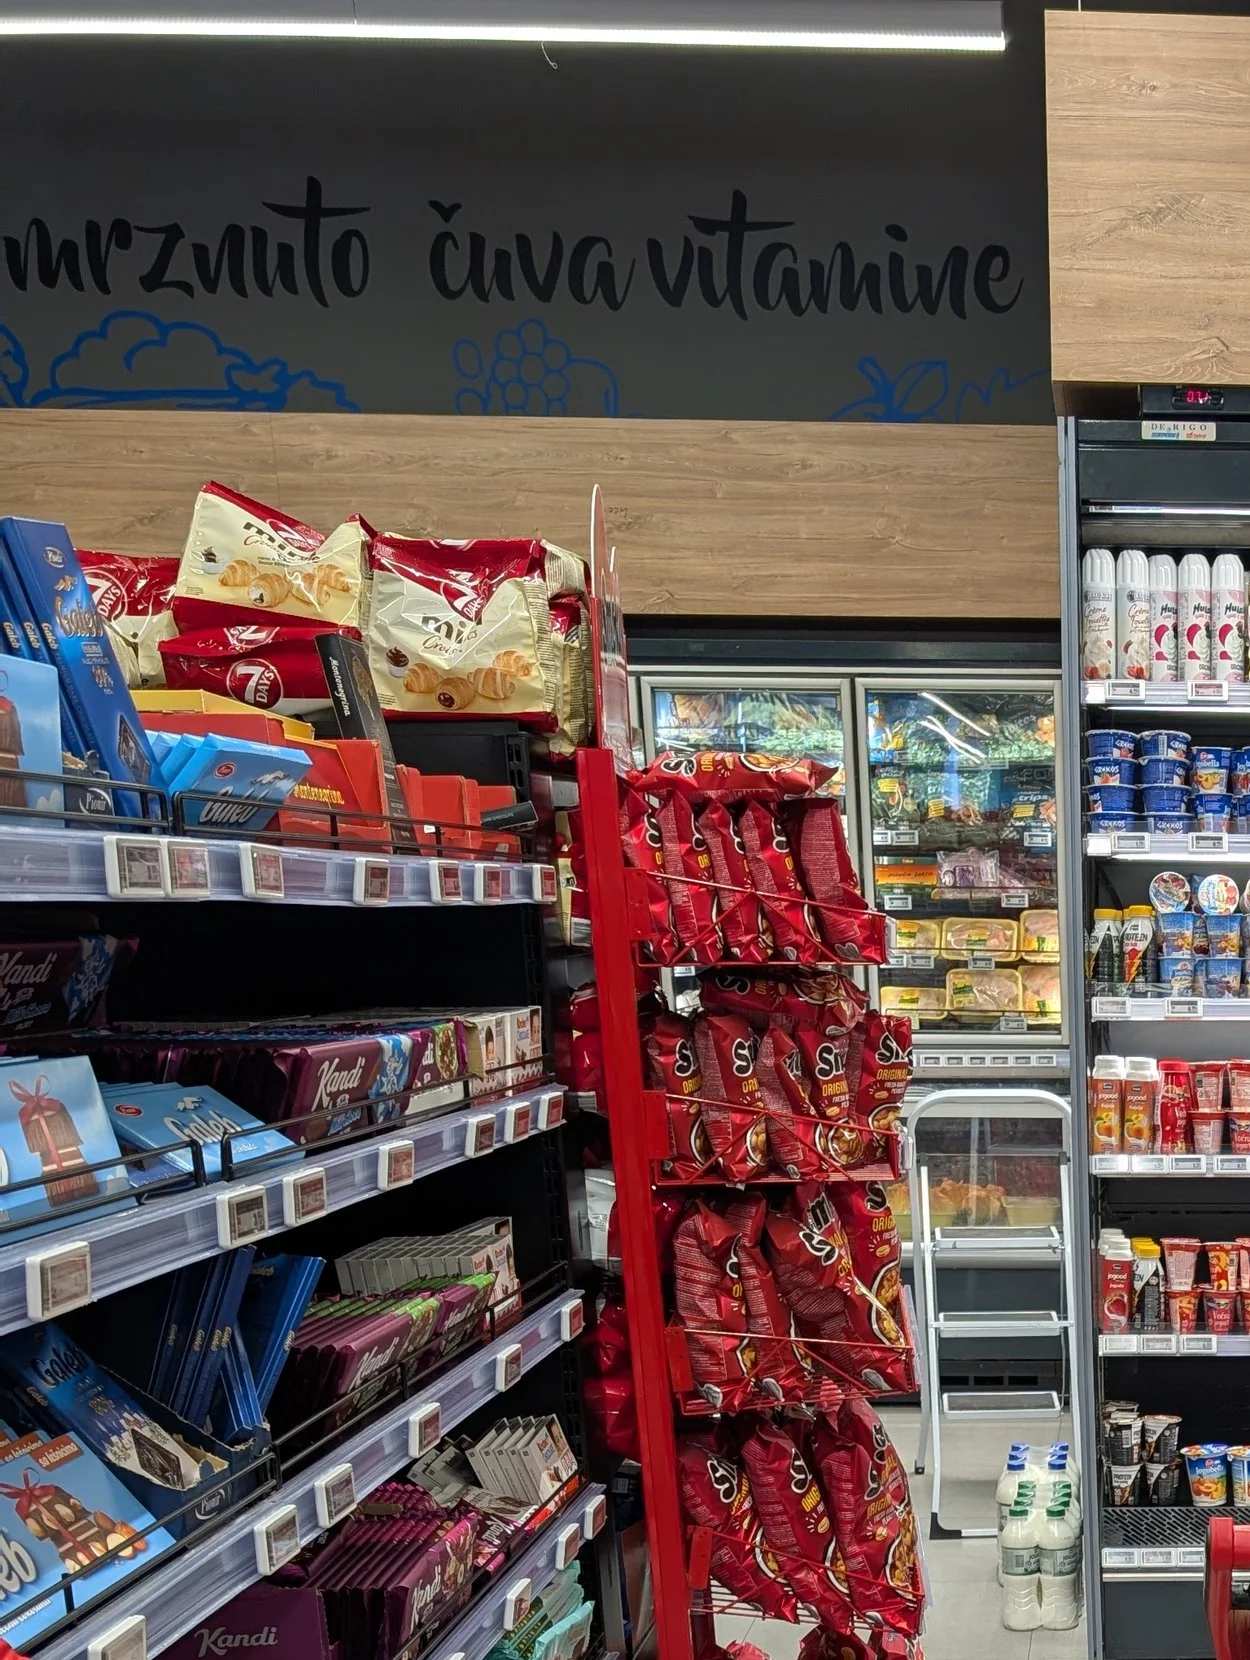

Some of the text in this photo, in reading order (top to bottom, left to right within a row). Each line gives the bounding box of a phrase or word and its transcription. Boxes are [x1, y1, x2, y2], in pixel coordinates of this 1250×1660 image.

[3, 176, 1025, 320] mrznuto čuva vitamine
[3, 621, 21, 650] Galeb
[23, 620, 40, 649] Galeb
[41, 622, 58, 650] Galeb
[54, 596, 104, 638] Galeb
[236, 664, 263, 709] 7
[256, 669, 276, 704] DAYS
[329, 655, 351, 717] Montenegrina
[311, 1056, 366, 1112] Kandi
[31, 1342, 88, 1389] Galeb
[356, 1337, 401, 1389] Kandi
[47, 1442, 79, 1463] lešnicima
[410, 1564, 443, 1636] Kandi
[193, 1625, 279, 1658] Kandi
